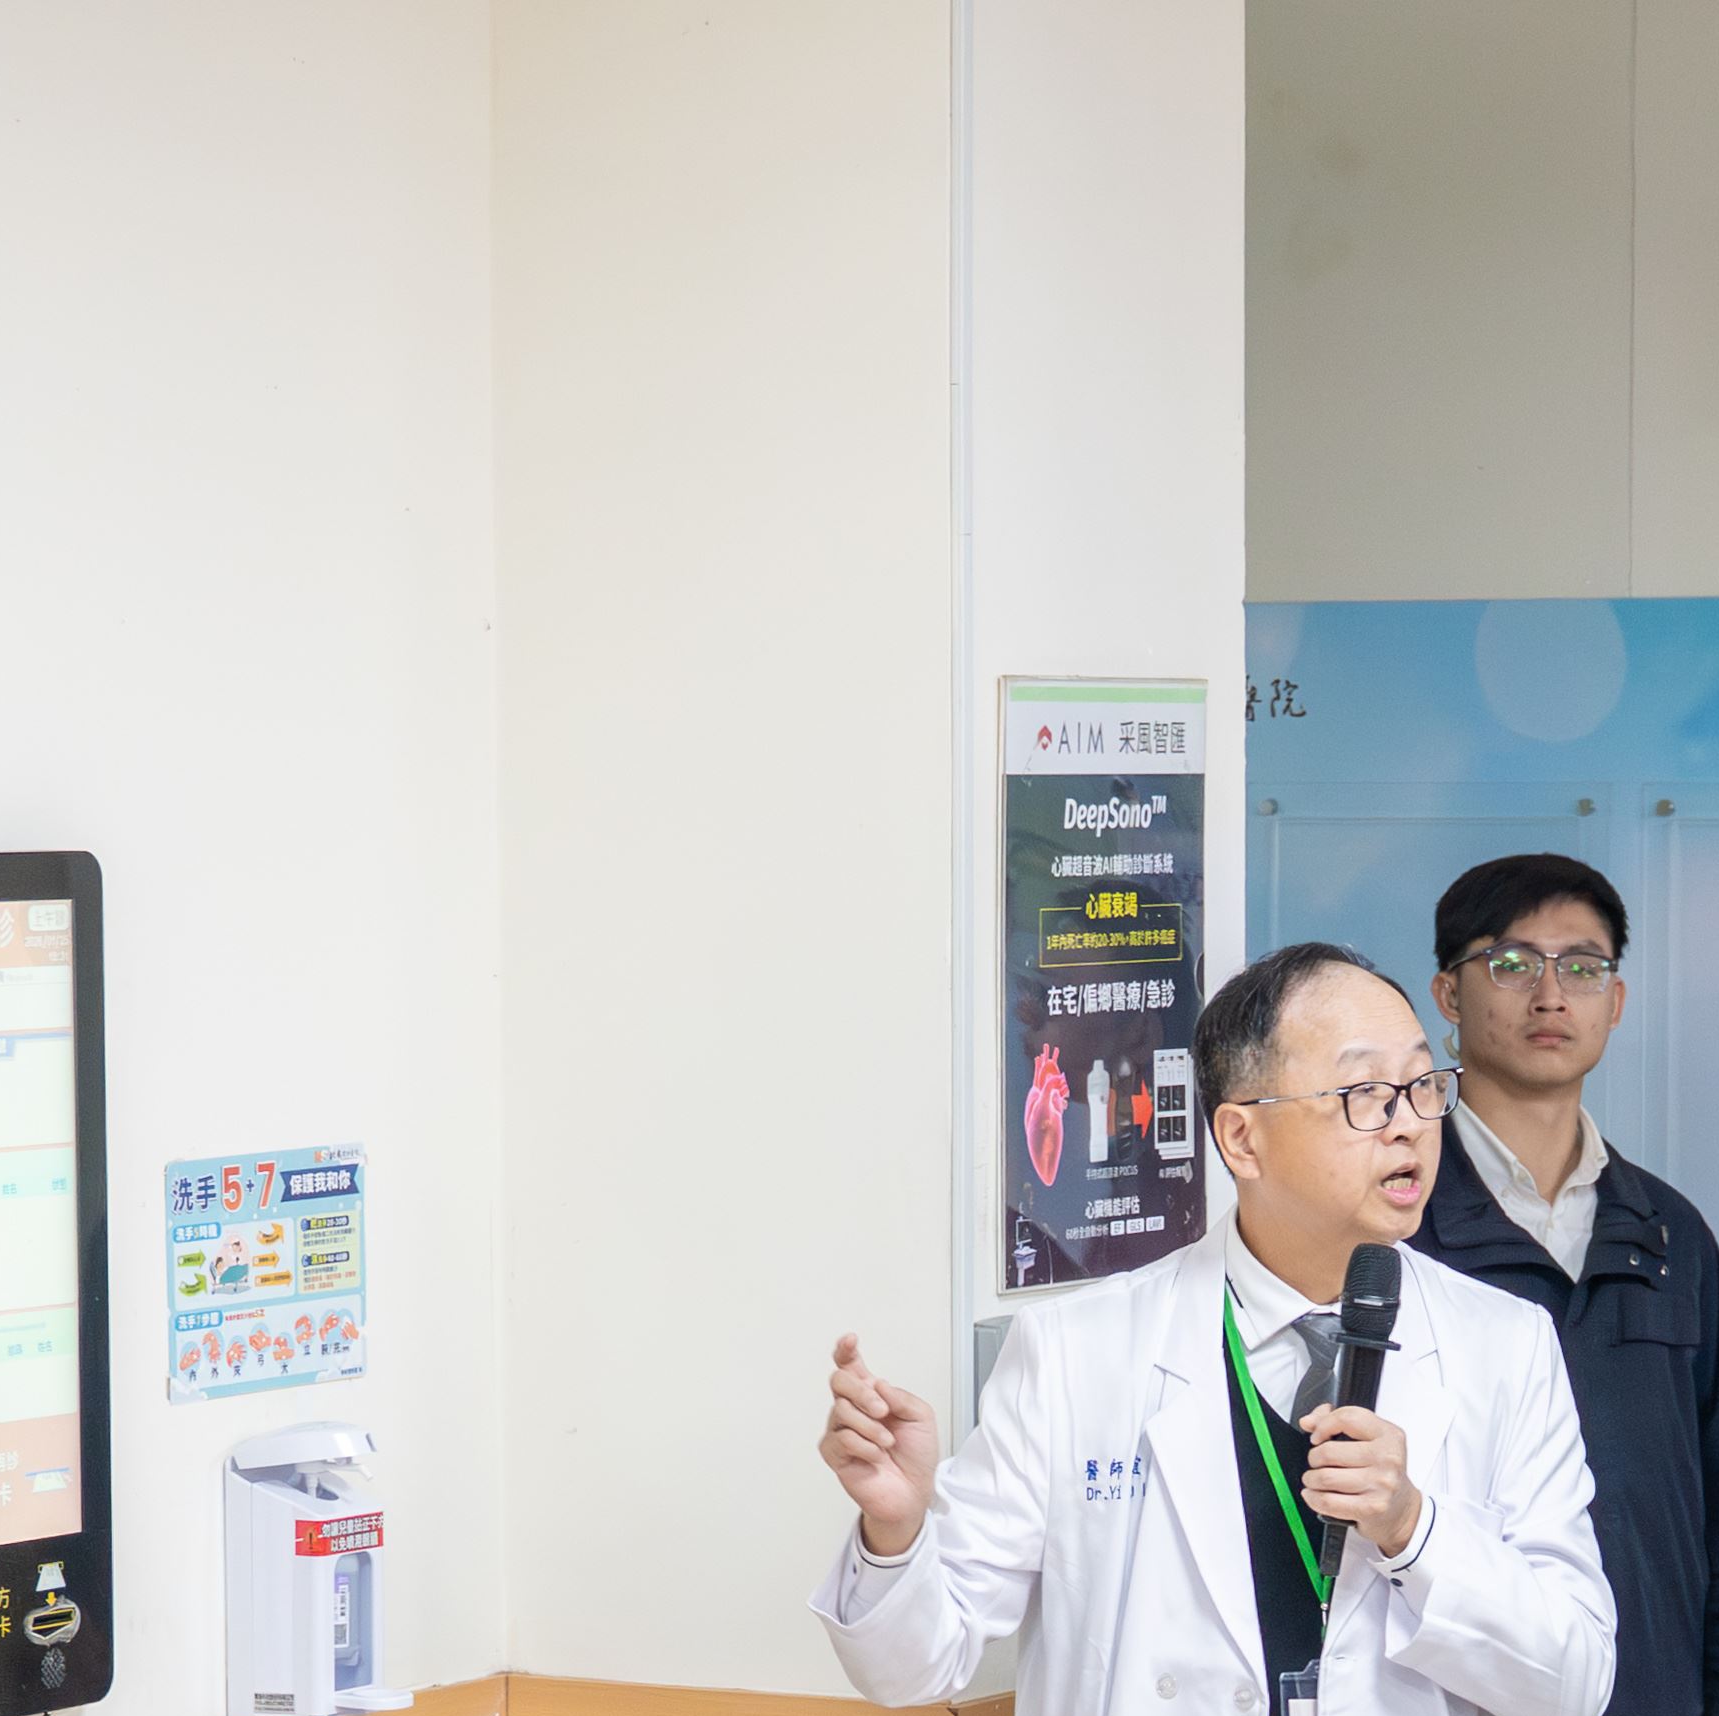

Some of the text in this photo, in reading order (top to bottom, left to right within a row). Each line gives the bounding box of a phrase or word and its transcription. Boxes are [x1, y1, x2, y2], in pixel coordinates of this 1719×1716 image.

[1057, 721, 1105, 754] AIM
[1085, 892, 1138, 919] 心臟衰竭
[1047, 979, 1176, 1017] 在宅/偏鄉醫療/急診
[289, 1169, 352, 1197] 保護我和你
